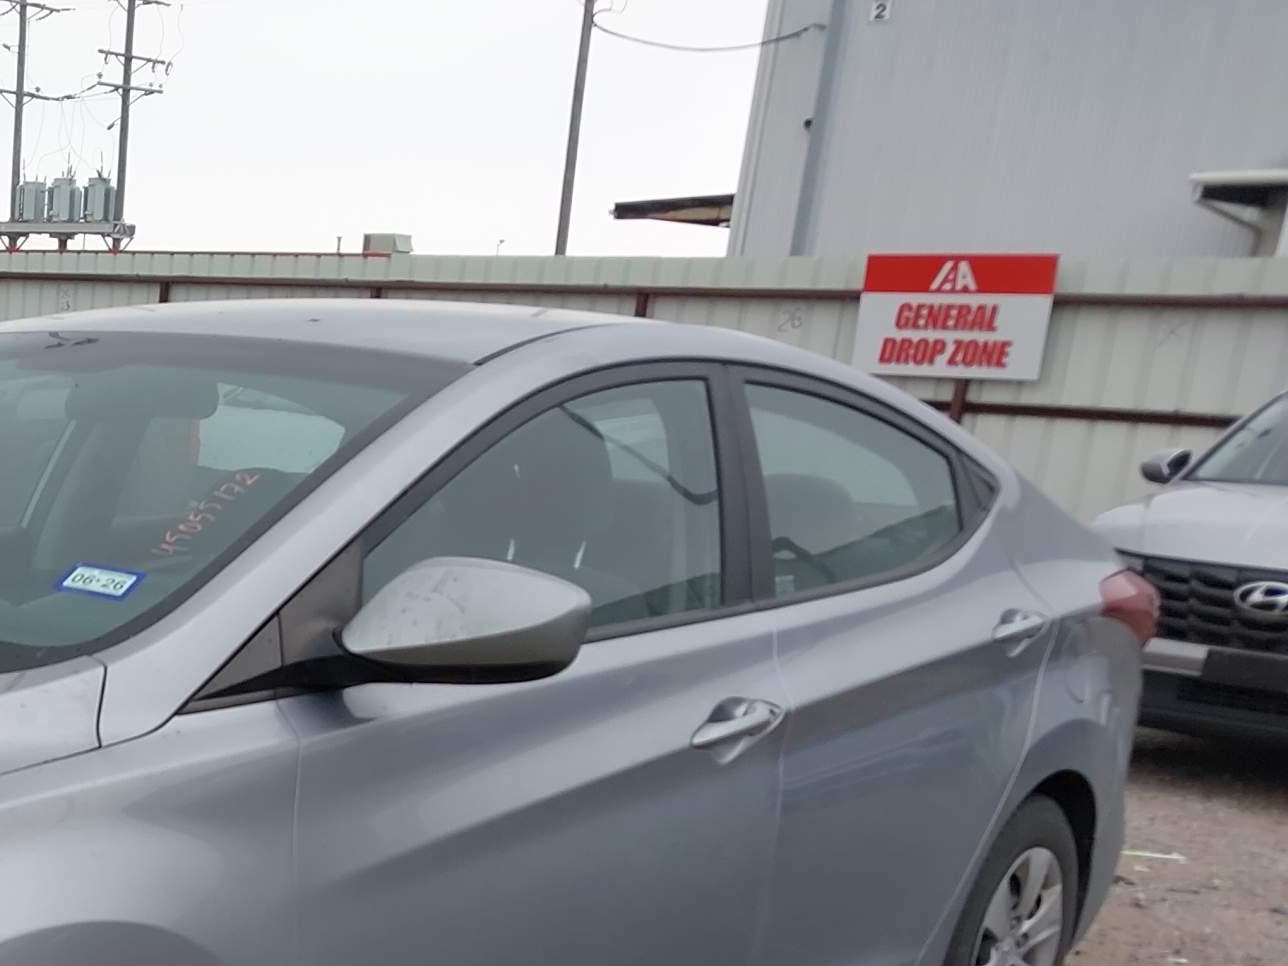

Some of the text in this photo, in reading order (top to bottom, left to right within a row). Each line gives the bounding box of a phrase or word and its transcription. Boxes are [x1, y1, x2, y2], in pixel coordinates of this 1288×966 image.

[874, 2, 887, 19] 2
[895, 302, 999, 332] GENERAL
[878, 337, 1013, 368] DROP ZONE
